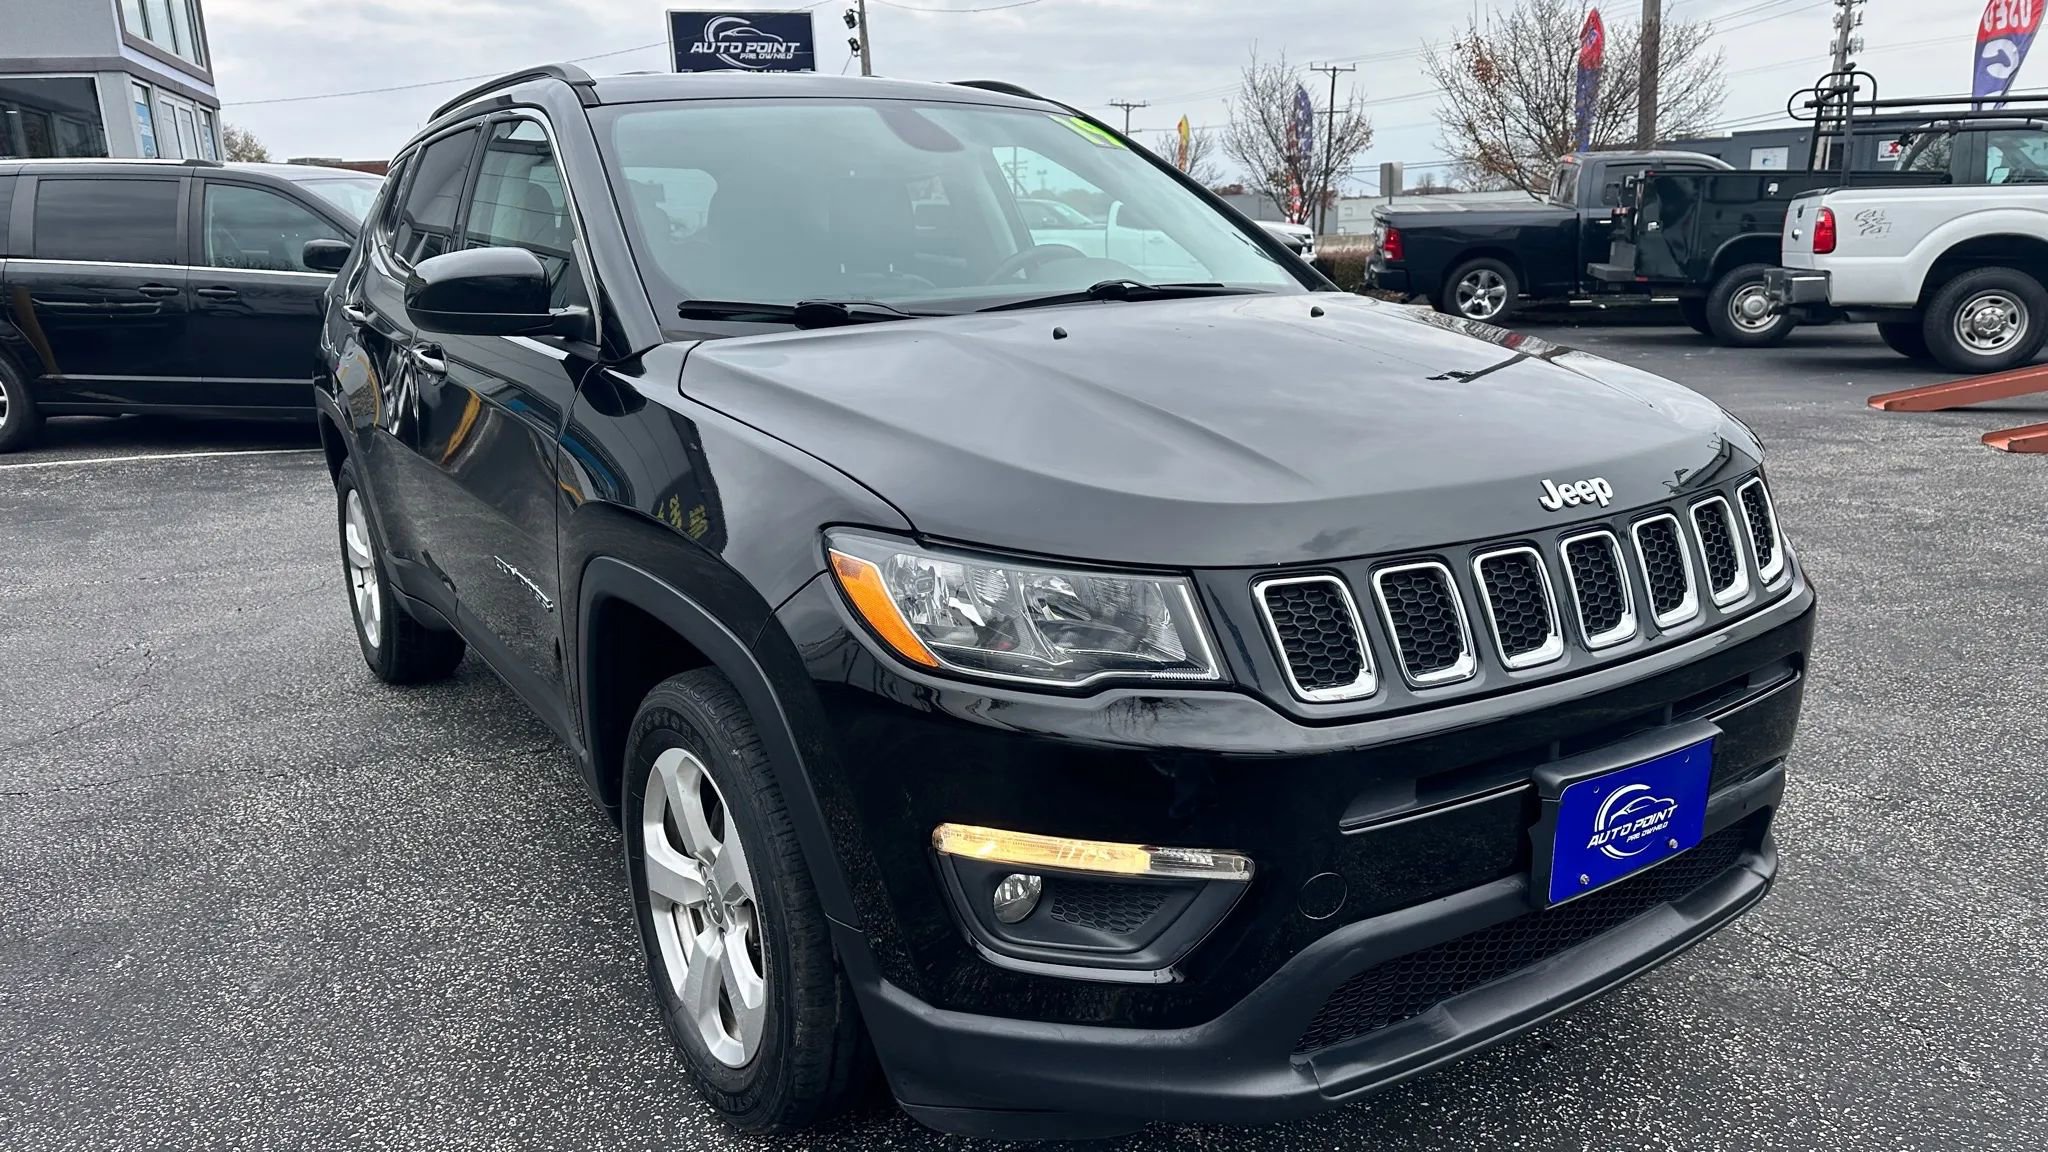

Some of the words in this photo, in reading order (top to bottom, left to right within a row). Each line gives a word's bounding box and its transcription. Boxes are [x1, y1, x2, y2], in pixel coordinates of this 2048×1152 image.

[690, 42, 742, 54] AUTO
[745, 42, 800, 54] POINT
[1538, 477, 1614, 511] Jeep
[1586, 822, 1633, 849] AUTO
[1632, 804, 1678, 832] POINT
[1626, 832, 1641, 843] PRE
[1641, 821, 1669, 837] OWNED
